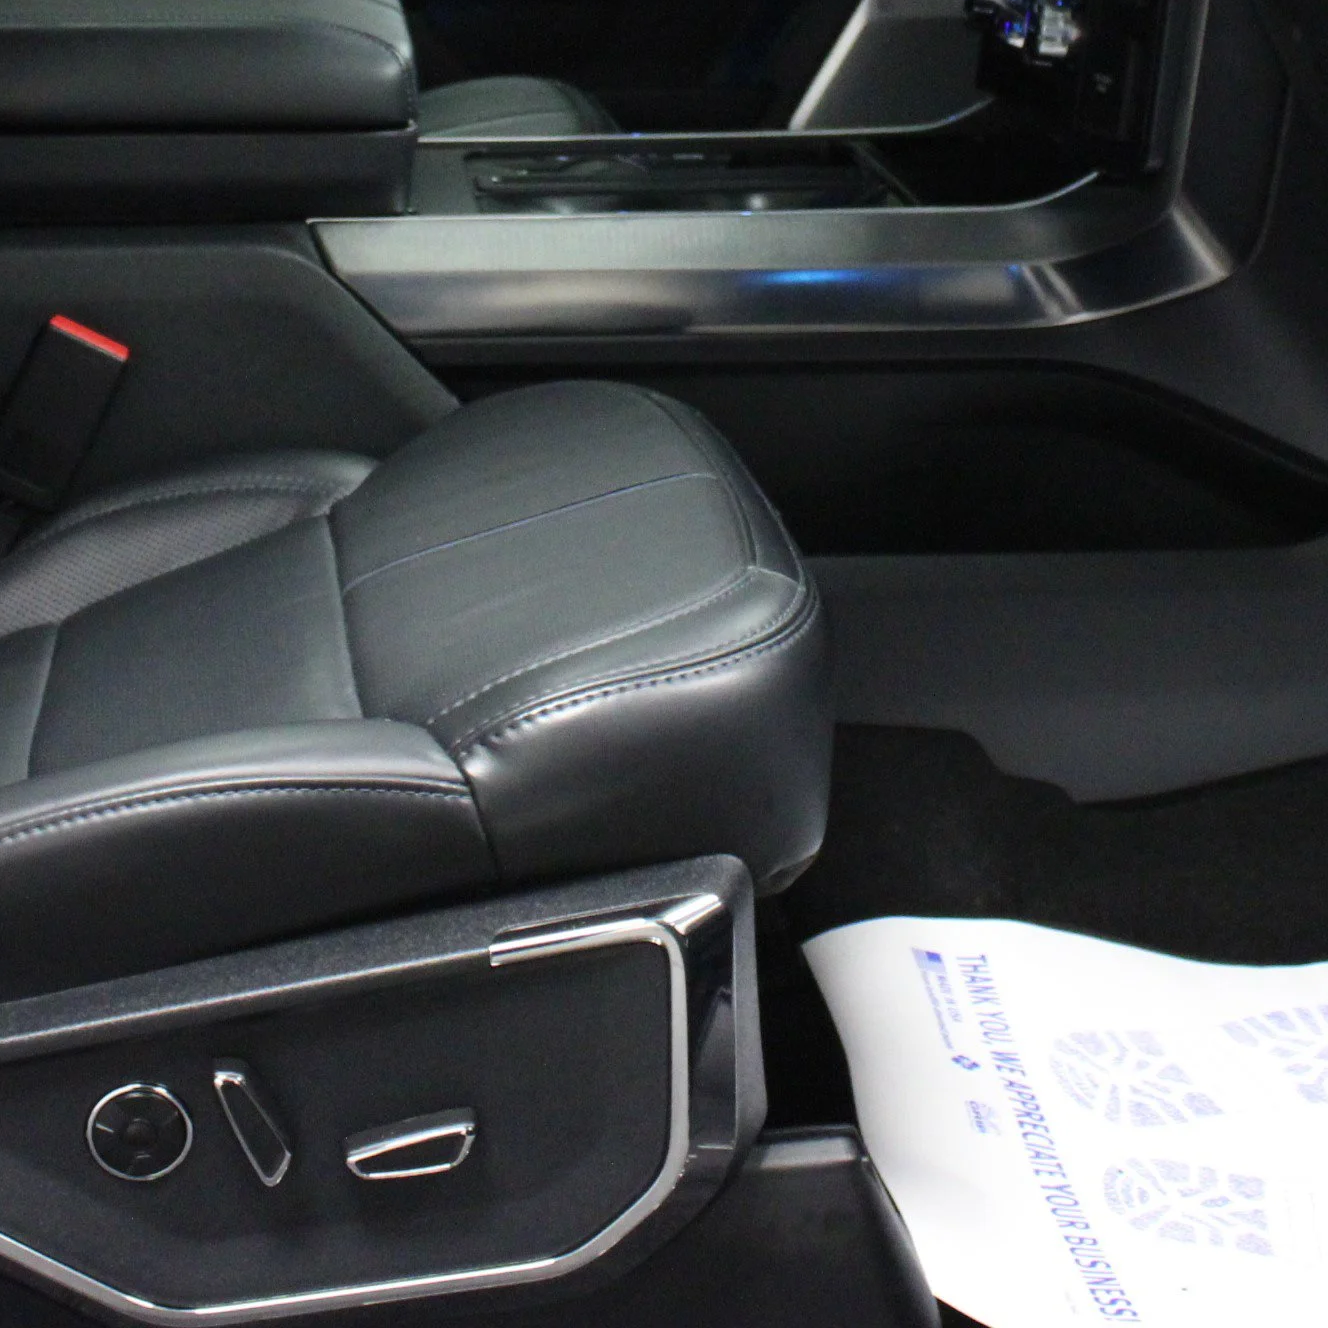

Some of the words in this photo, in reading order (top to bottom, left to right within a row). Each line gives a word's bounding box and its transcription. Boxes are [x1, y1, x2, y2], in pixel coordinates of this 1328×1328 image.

[956, 954, 1001, 1006] THANK
[989, 1050, 1026, 1078] WE
[999, 1076, 1068, 1179] APPRECIATE
[1040, 1184, 1090, 1229] YOUR
[1063, 1234, 1142, 1322] BUSINESS!
